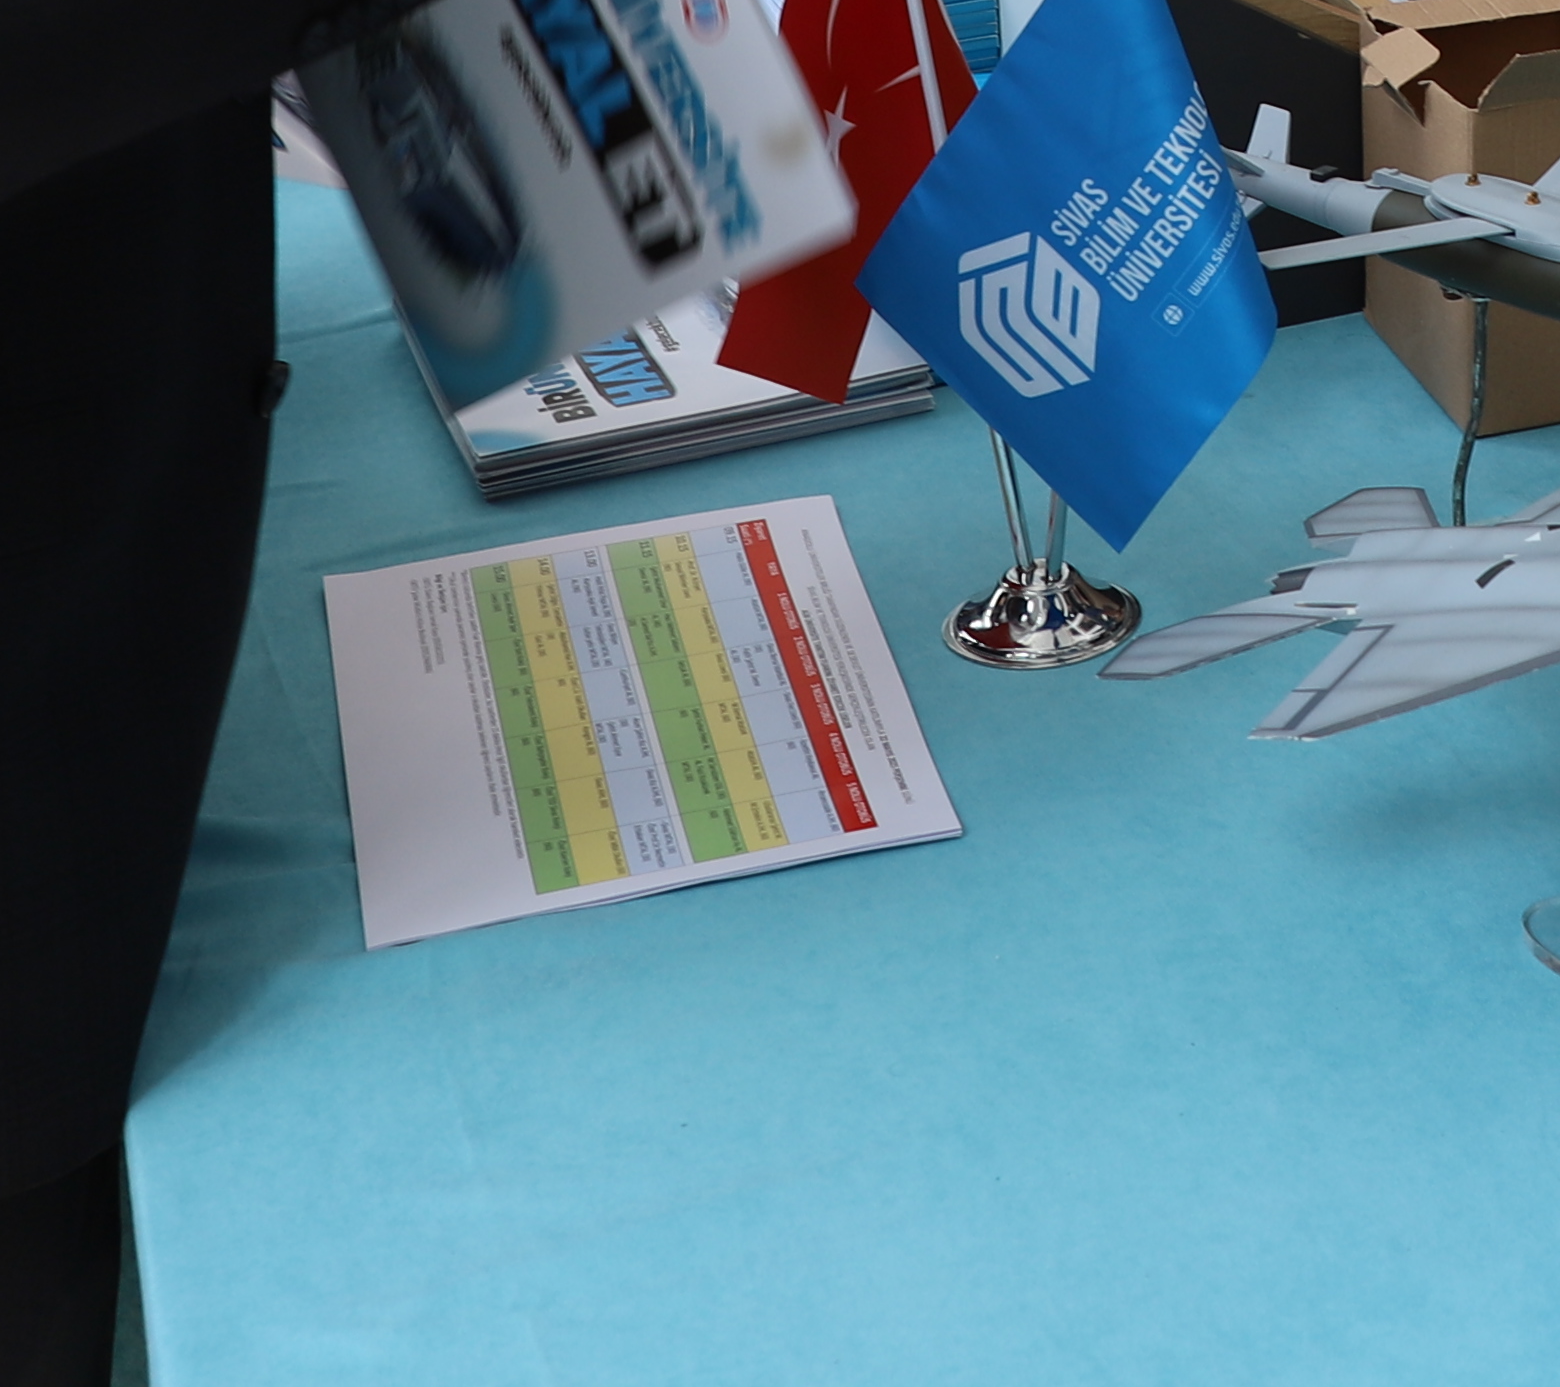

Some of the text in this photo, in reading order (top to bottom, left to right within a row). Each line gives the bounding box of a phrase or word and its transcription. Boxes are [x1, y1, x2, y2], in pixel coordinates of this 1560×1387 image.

[1050, 178, 1110, 247] SİVAS
[1079, 206, 1141, 277] BİLİM
[1121, 176, 1164, 217] VE
[1105, 148, 1223, 303] ÜNİVERSİTESİ
